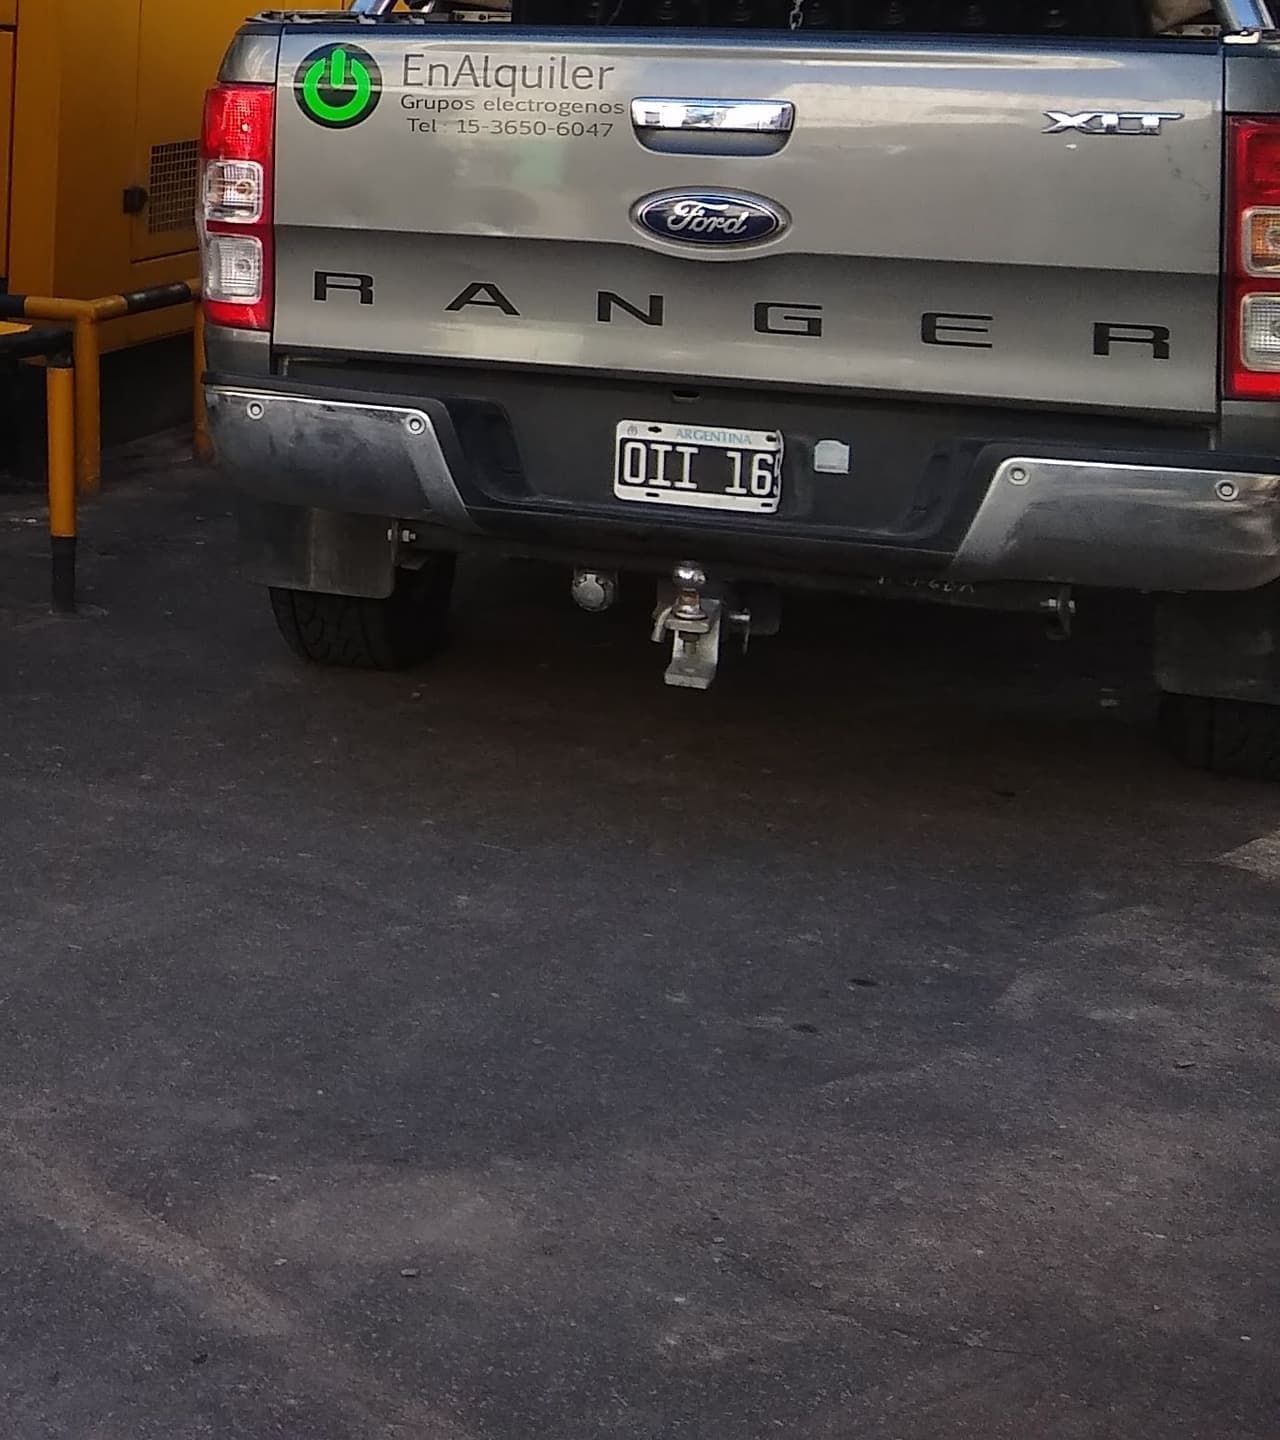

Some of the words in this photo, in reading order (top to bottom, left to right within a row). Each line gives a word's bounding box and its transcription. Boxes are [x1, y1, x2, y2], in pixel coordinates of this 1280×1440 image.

[402, 53, 616, 98] EnAlquiler
[400, 94, 476, 114] Grupos
[483, 96, 625, 117] electrogenos
[456, 118, 614, 137] 15-3650-6047
[1040, 110, 1185, 136] XLT
[666, 200, 750, 235] Ford
[313, 270, 1170, 360] RANGER
[676, 428, 753, 445] ARGENTINA
